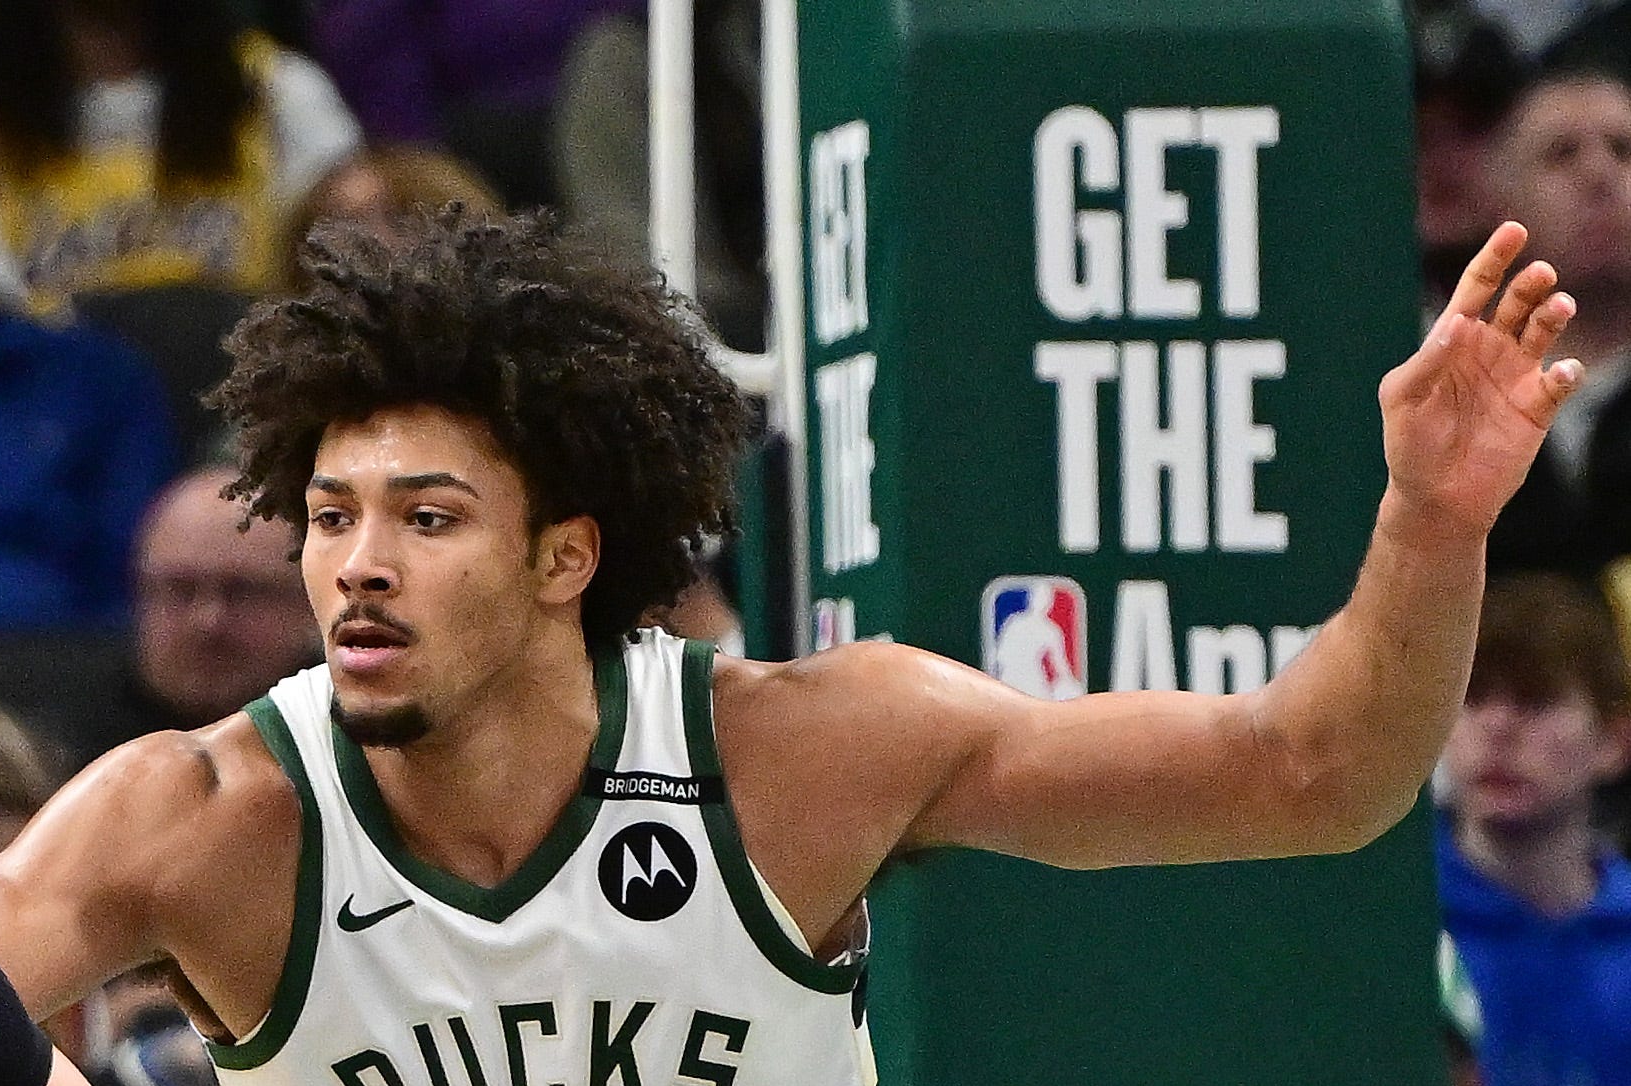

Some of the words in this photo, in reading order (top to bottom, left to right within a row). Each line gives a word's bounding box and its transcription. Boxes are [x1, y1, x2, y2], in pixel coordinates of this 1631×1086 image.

[1033, 105, 1281, 322] GET
[1033, 339, 1290, 554] THE
[603, 777, 700, 799] BRIDGEMAN
